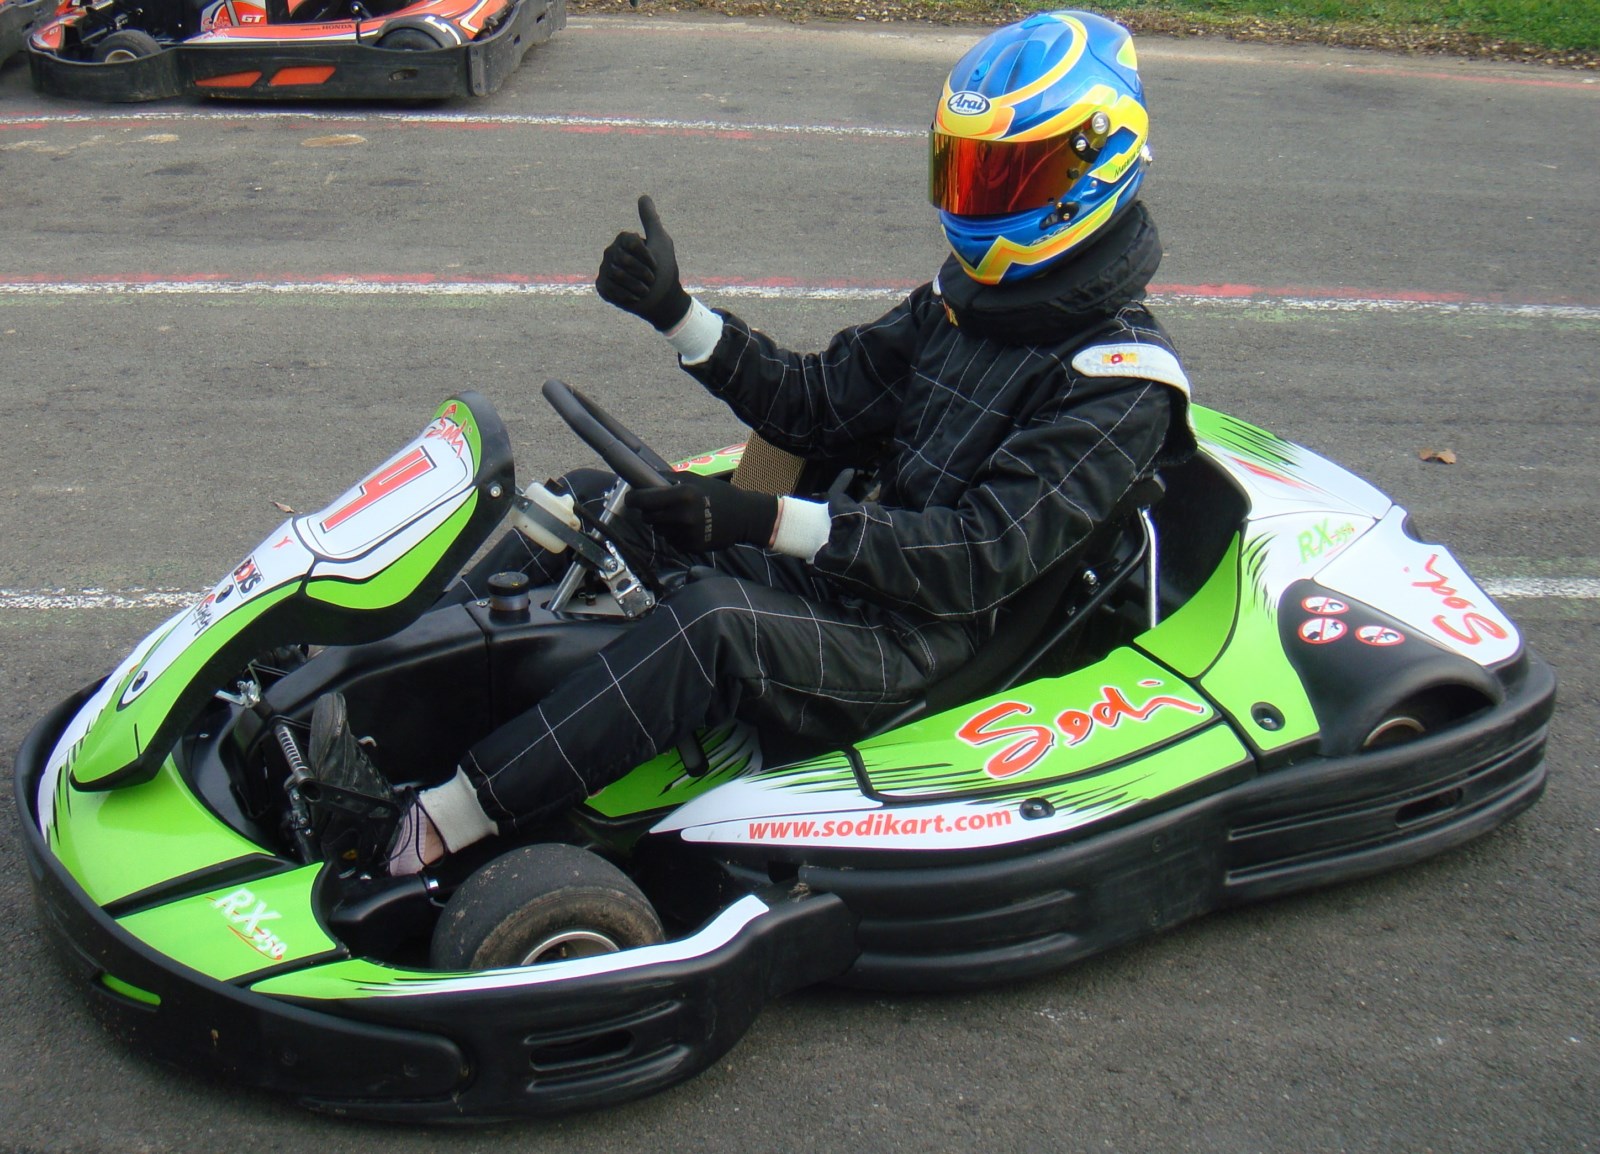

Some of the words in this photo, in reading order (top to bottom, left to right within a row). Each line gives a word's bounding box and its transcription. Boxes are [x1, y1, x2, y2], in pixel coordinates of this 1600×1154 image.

[242, 14, 264, 23] GT
[951, 94, 985, 111] Arai
[1403, 553, 1508, 646] Sodi
[956, 679, 1205, 779] Sodi
[749, 810, 1012, 840] www.sodikart.com
